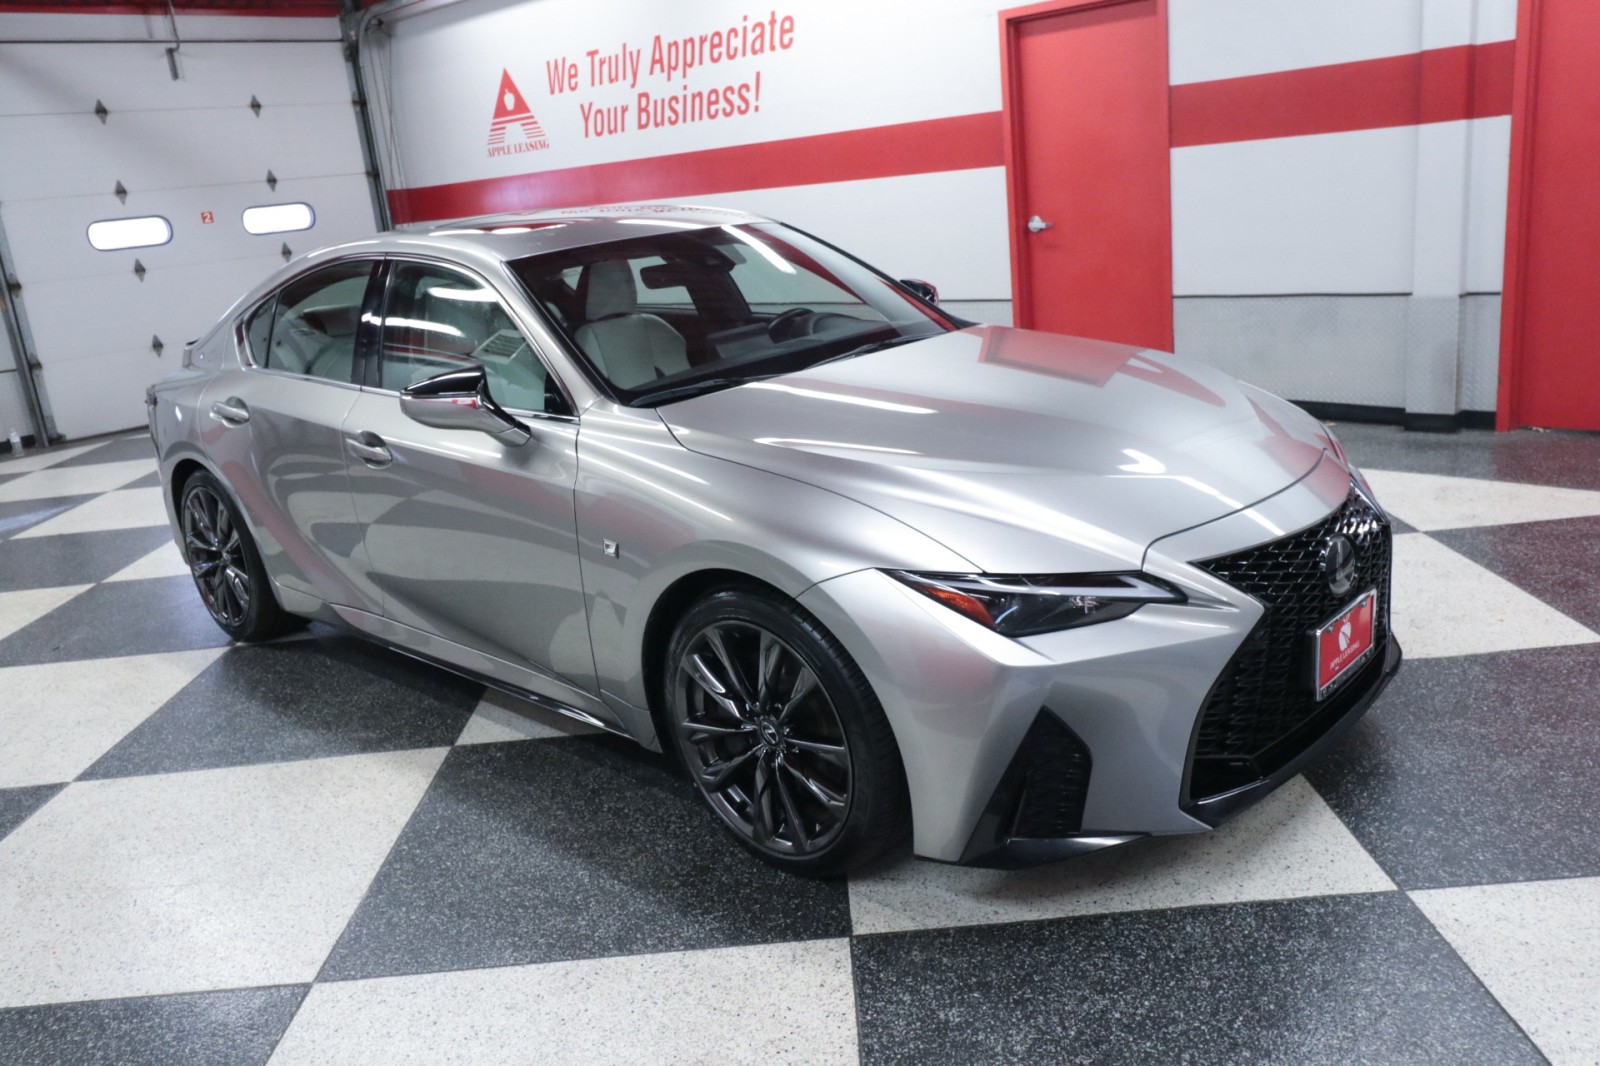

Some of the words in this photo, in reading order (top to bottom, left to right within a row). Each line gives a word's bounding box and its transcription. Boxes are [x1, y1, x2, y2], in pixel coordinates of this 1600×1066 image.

[546, 57, 578, 95] We
[586, 43, 641, 89] Truly
[649, 10, 794, 81] Appreciate
[580, 102, 628, 138] Your
[637, 71, 761, 130] Business!
[487, 144, 512, 158] APPLE
[514, 139, 550, 154] LEASING
[204, 212, 212, 223] 2
[1330, 654, 1343, 670] APPLE
